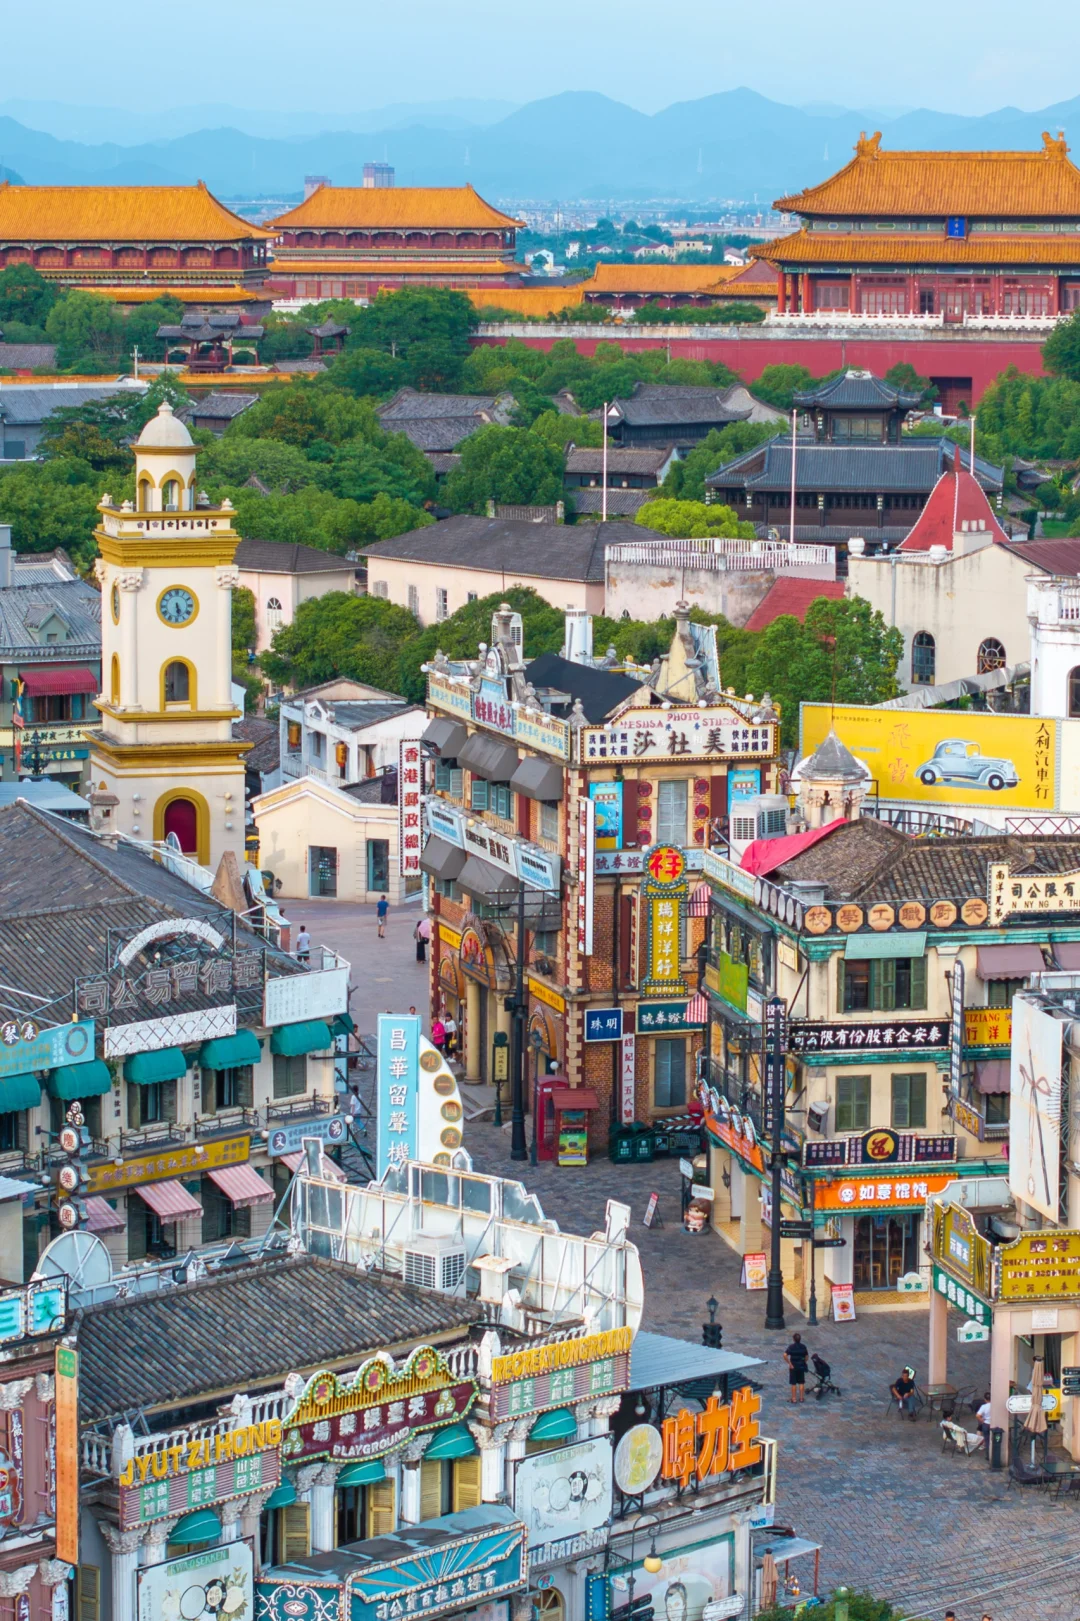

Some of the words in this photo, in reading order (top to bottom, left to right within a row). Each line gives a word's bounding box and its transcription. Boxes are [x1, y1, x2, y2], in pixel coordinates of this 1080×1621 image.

[656, 901, 674, 976] 瑞祥洋行
[964, 1012, 1000, 1023] UIXIANG
[858, 1182, 929, 1201] 如意馄饨
[215, 1418, 283, 1460] HONG
[332, 1426, 413, 1458] PLAYGROUND
